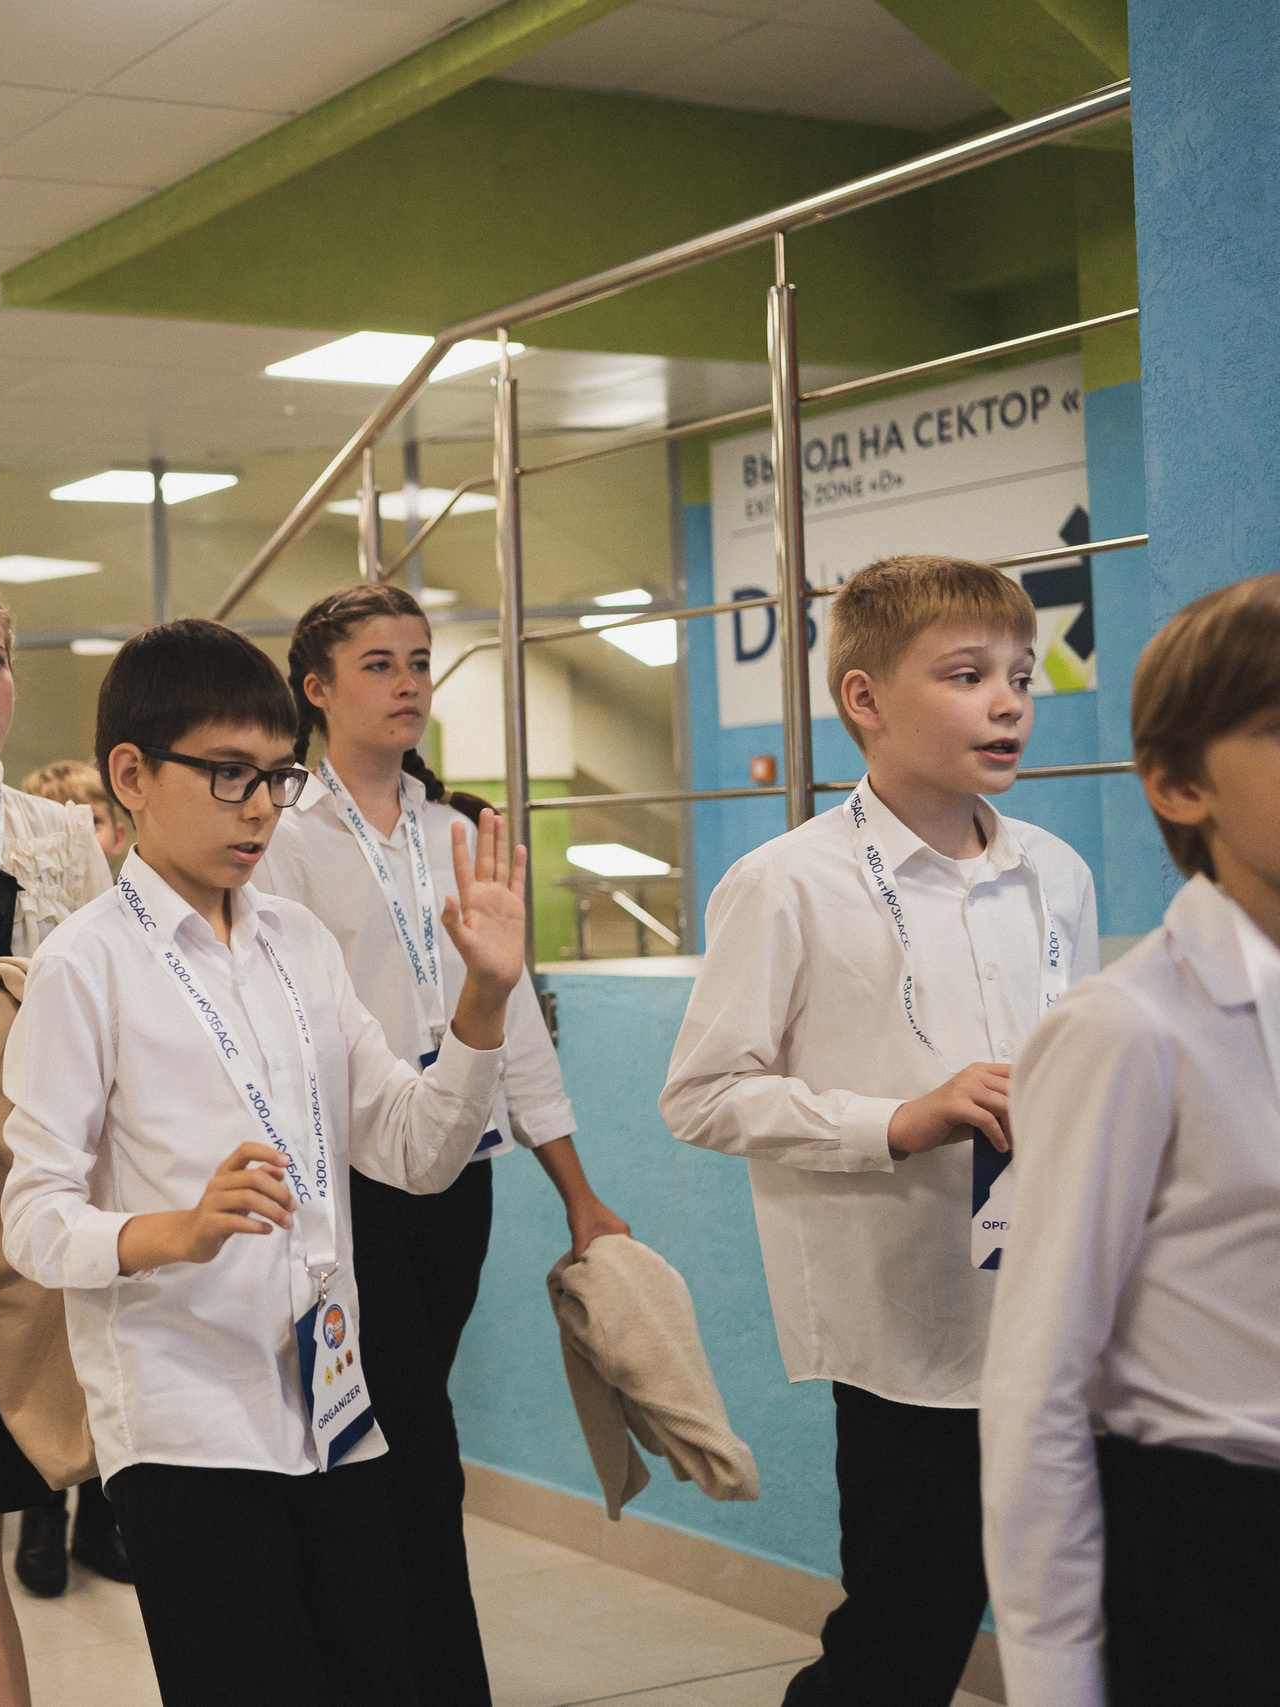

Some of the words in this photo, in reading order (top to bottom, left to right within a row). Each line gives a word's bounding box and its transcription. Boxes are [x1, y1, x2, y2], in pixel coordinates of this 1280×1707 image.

[742, 434, 851, 488] ВЫОД
[859, 422, 906, 460] НА
[913, 385, 1051, 451] СЕКТОР
[814, 474, 863, 505] ZONE
[318, 1384, 361, 1430] ORGANIZER
